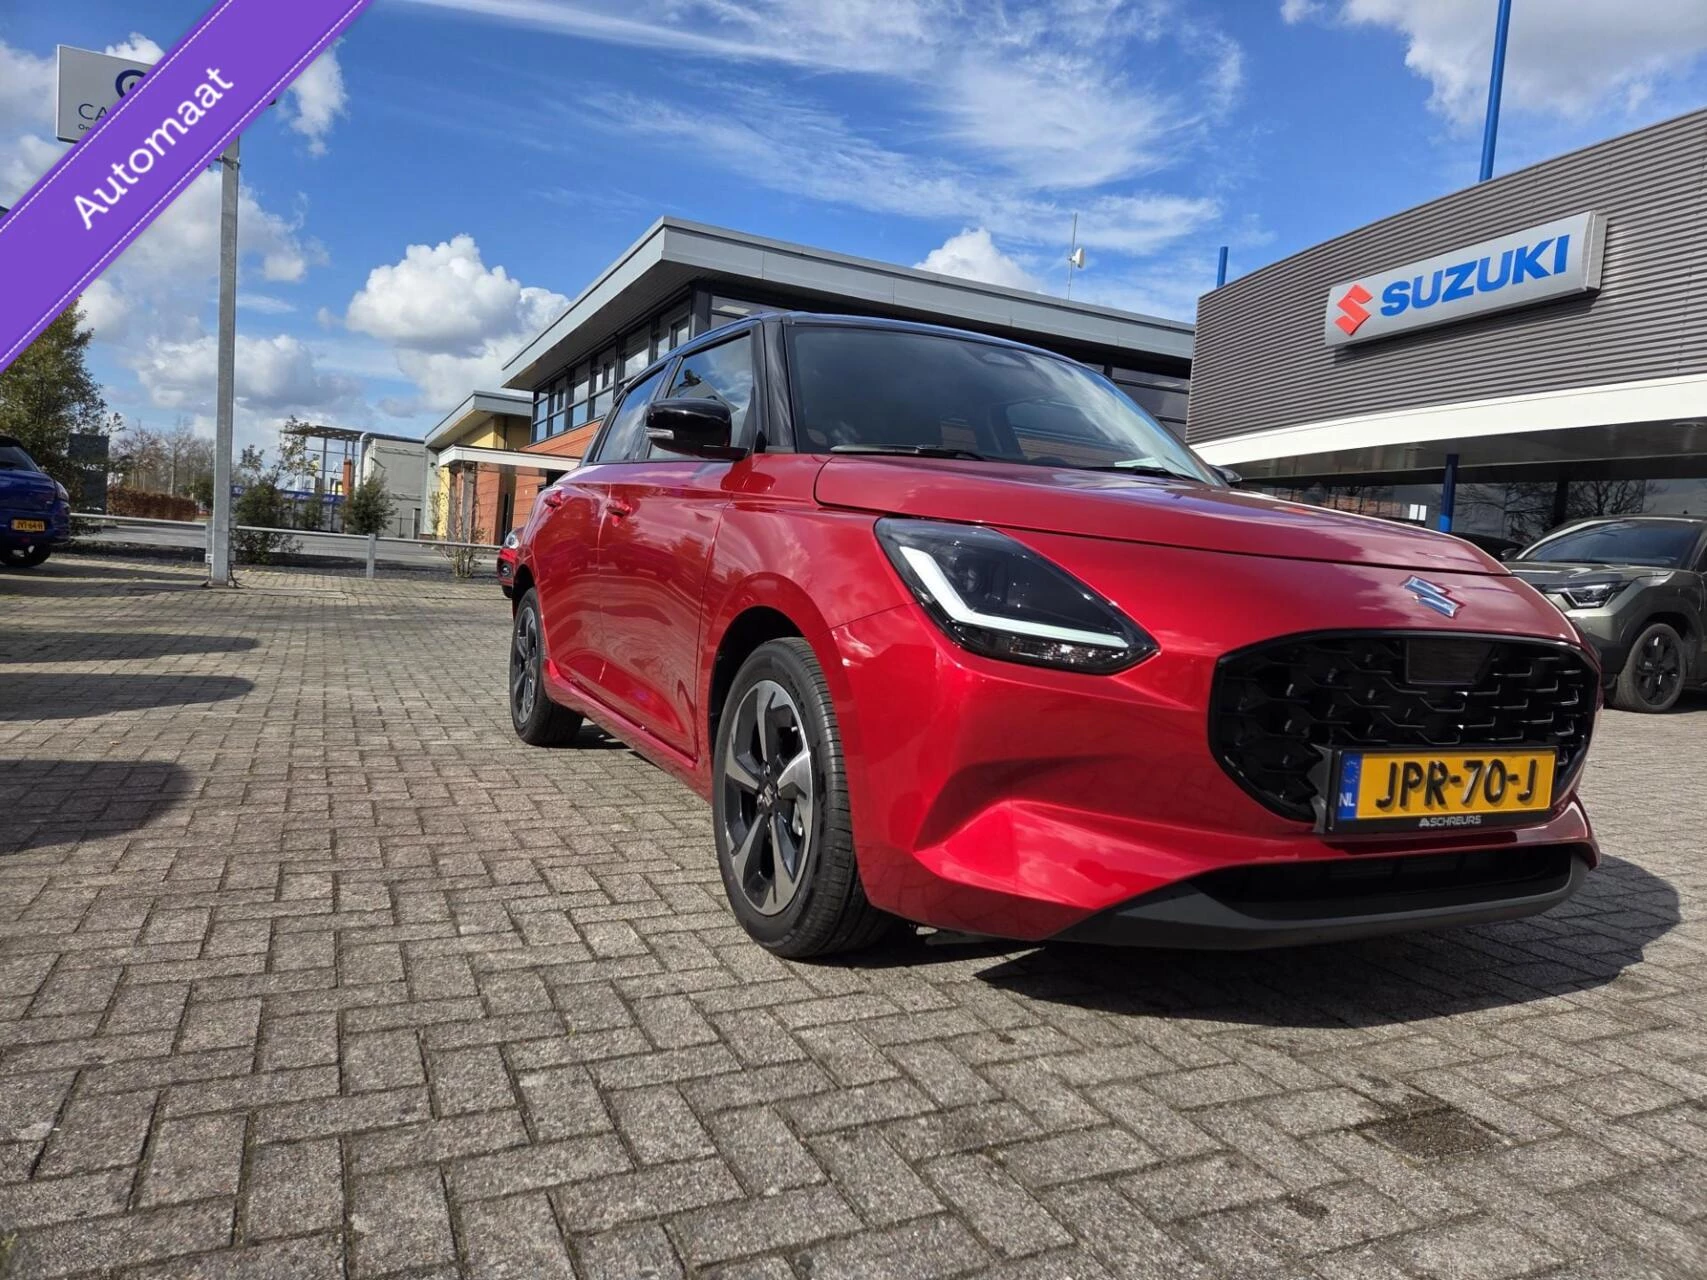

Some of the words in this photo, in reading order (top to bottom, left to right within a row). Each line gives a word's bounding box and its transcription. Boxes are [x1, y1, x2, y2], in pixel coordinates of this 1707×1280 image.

[1380, 234, 1570, 316] SUZUKI
[1338, 792, 1355, 807] NL
[1376, 758, 1538, 809] JPR-70-J
[1428, 815, 1481, 827] SCHREURS
